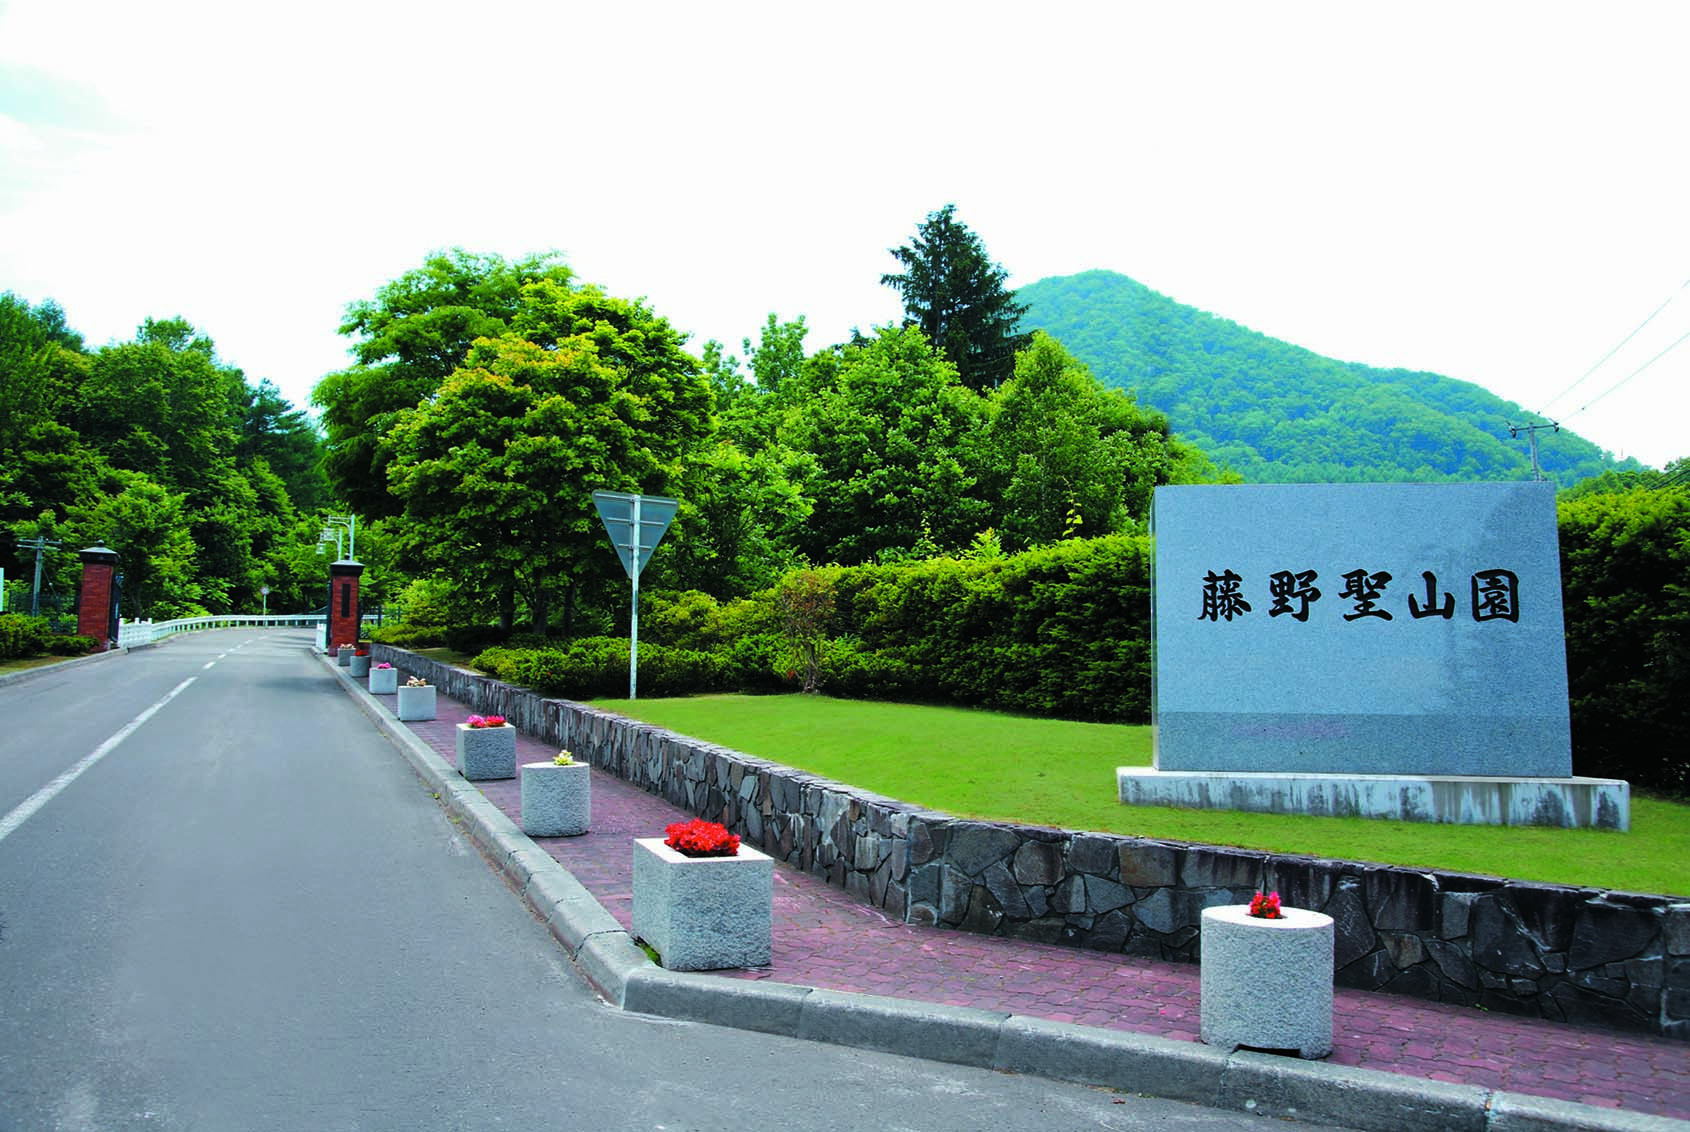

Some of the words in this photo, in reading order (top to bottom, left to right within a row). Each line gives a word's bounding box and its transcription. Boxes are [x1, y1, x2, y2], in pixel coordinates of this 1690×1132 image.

[1198, 568, 1519, 623] 藤野聖山園
